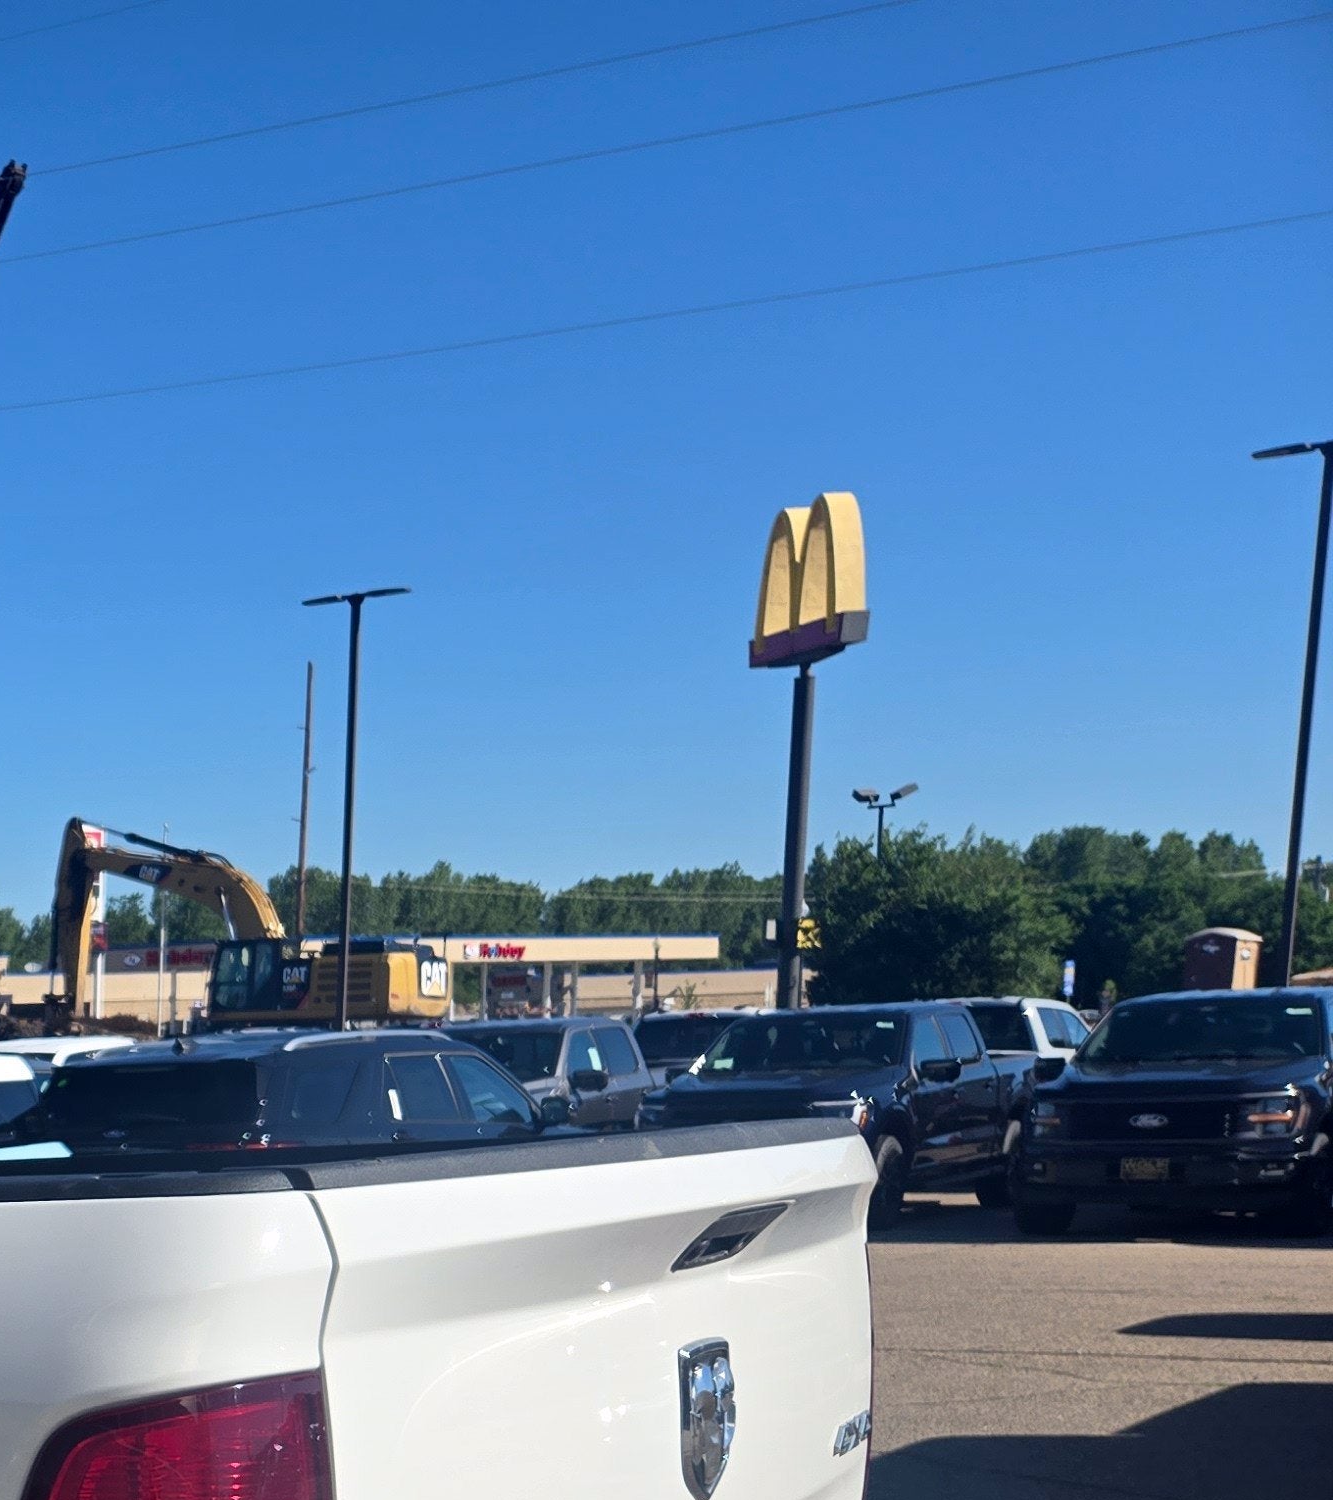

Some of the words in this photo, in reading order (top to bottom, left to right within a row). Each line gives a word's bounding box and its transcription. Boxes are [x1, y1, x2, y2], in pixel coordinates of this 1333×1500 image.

[138, 864, 161, 881] CAT
[283, 966, 308, 984] CAT
[420, 961, 448, 997] CAT
